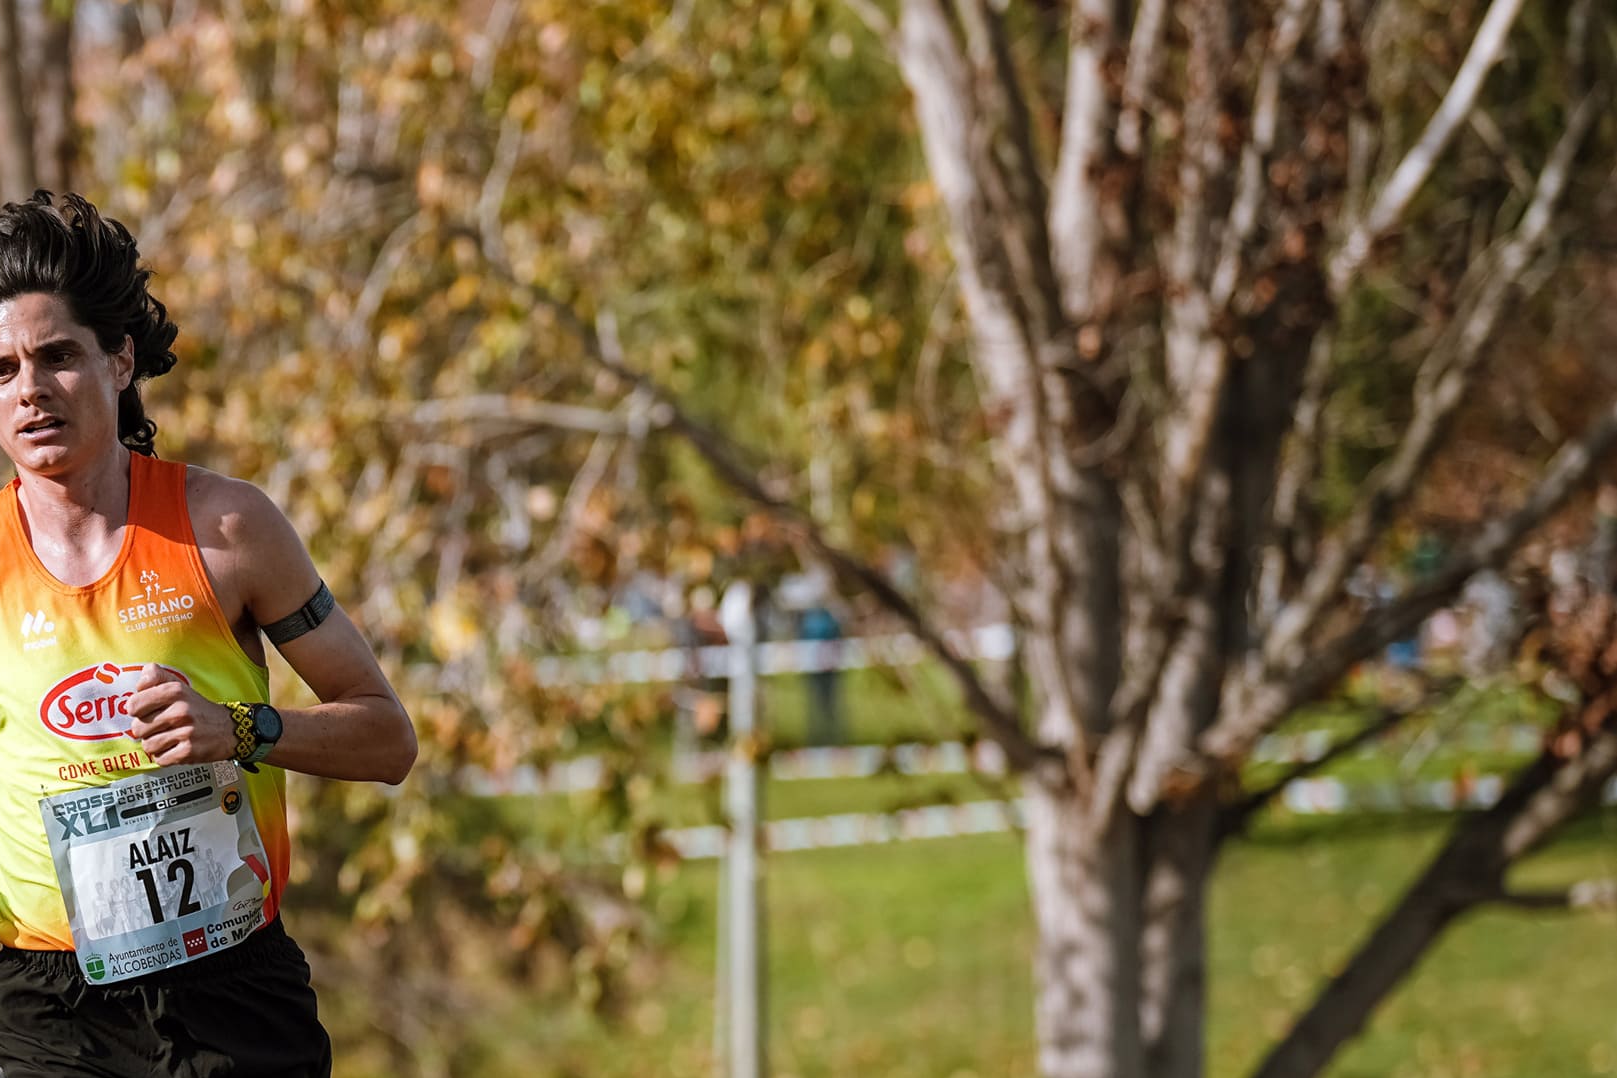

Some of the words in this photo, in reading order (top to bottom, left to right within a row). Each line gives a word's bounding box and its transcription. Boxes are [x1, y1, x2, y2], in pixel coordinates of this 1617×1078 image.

[118, 595, 194, 624] SERRANO
[125, 621, 147, 632] CLUB
[148, 612, 193, 628] ATLETISMO
[56, 690, 134, 729] Serra
[59, 761, 100, 780] COME
[102, 751, 141, 773] BIEN
[53, 792, 115, 817] CROSS
[56, 805, 120, 840] XLI
[129, 827, 195, 870] ALAIZ
[135, 858, 202, 924] 12
[108, 942, 166, 964] Ayuntamiento
[167, 937, 179, 948] de
[210, 936, 228, 949] de
[111, 948, 183, 977] ALCOBENDAS
